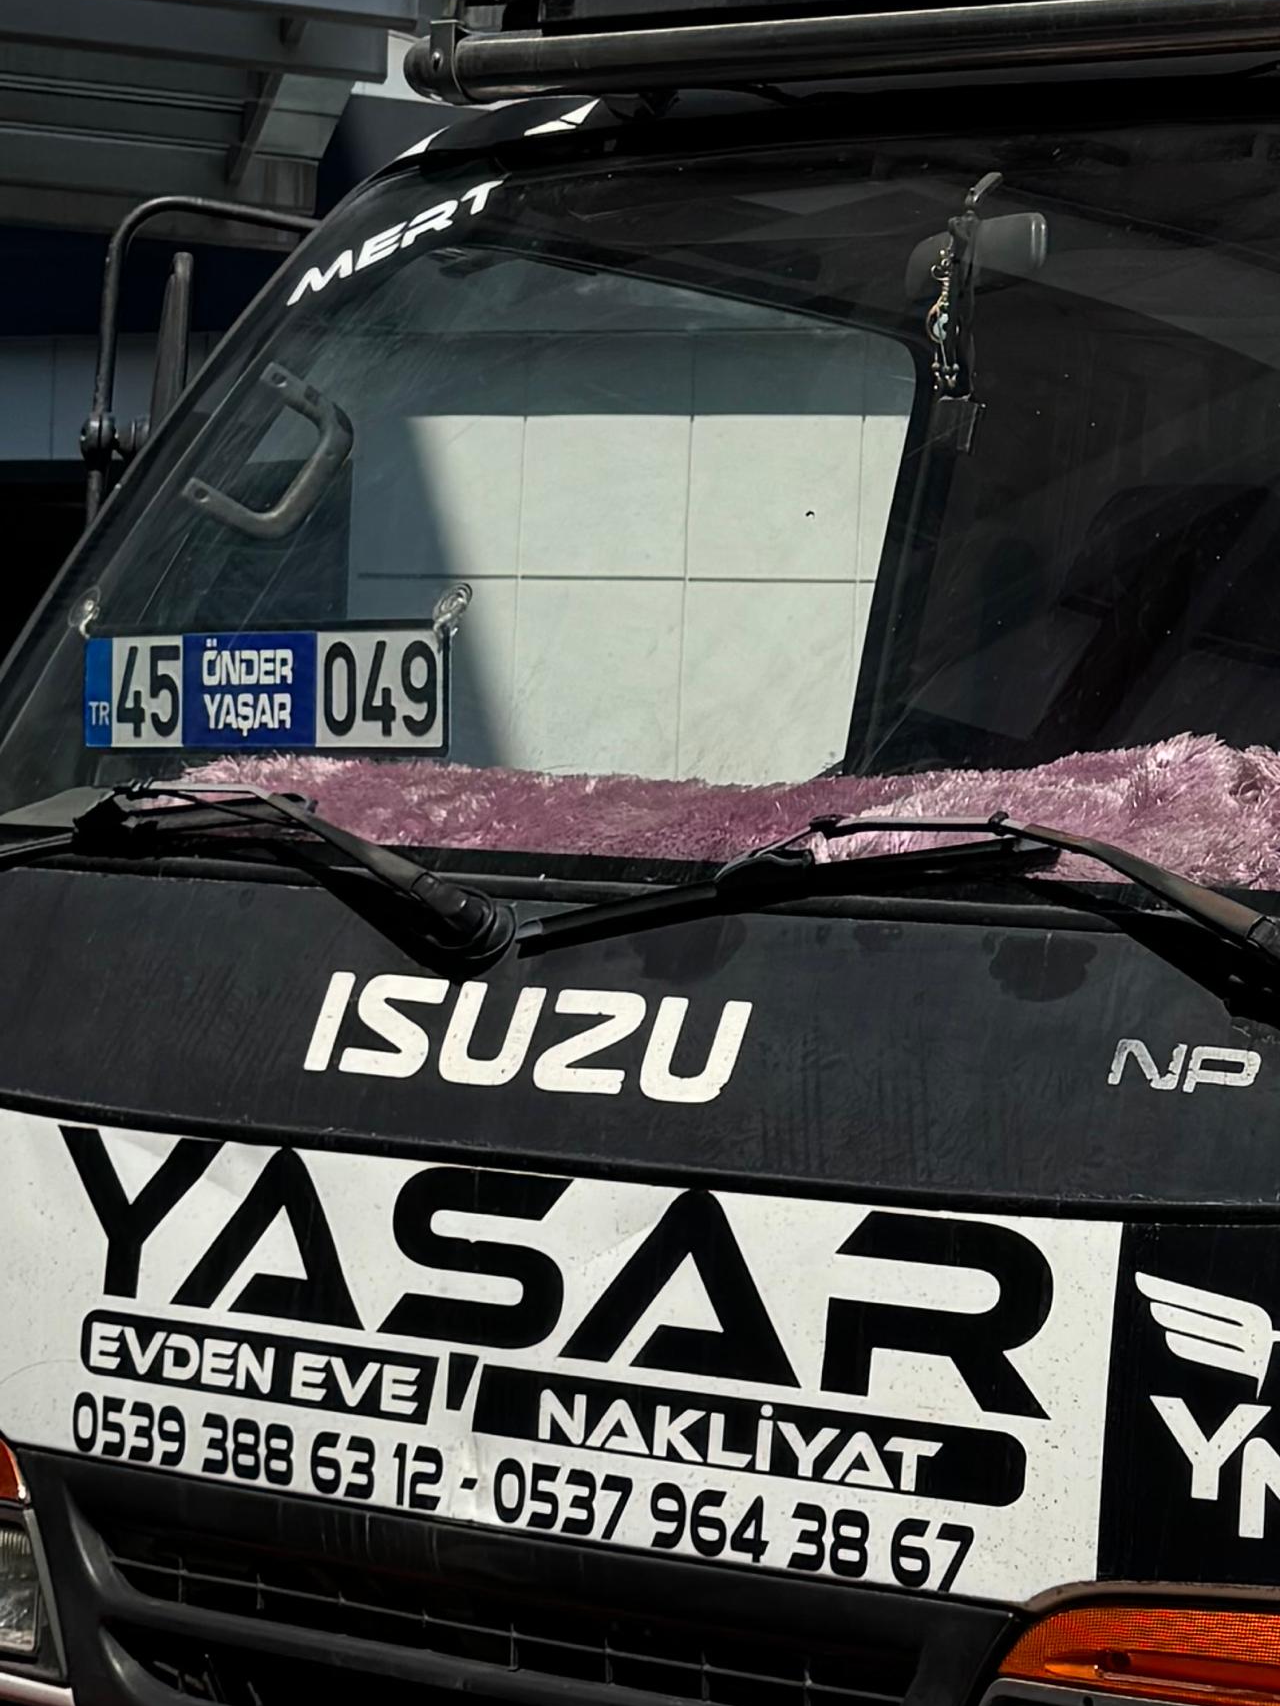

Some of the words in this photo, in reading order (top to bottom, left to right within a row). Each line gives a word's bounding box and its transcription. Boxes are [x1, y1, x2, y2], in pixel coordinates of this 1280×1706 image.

[286, 179, 504, 307] MERT
[116, 645, 180, 737] 45
[202, 638, 294, 686] ÖNDER
[323, 640, 437, 737] 049
[88, 701, 110, 727] TR
[203, 693, 293, 737] YAŞAR
[303, 971, 753, 1104] ISUZU
[1107, 1038, 1261, 1093] NP
[88, 1320, 276, 1394] EVDEN
[290, 1351, 422, 1415] EVE
[537, 1389, 944, 1492] NAKLİYAT
[72, 1391, 186, 1466] 0539
[201, 1412, 294, 1486] 388
[310, 1431, 375, 1499] 63
[393, 1442, 443, 1510] 12
[493, 1458, 633, 1541] 0537
[650, 1483, 769, 1563] 964
[787, 1502, 870, 1578] 38
[890, 1518, 975, 1593] 67
